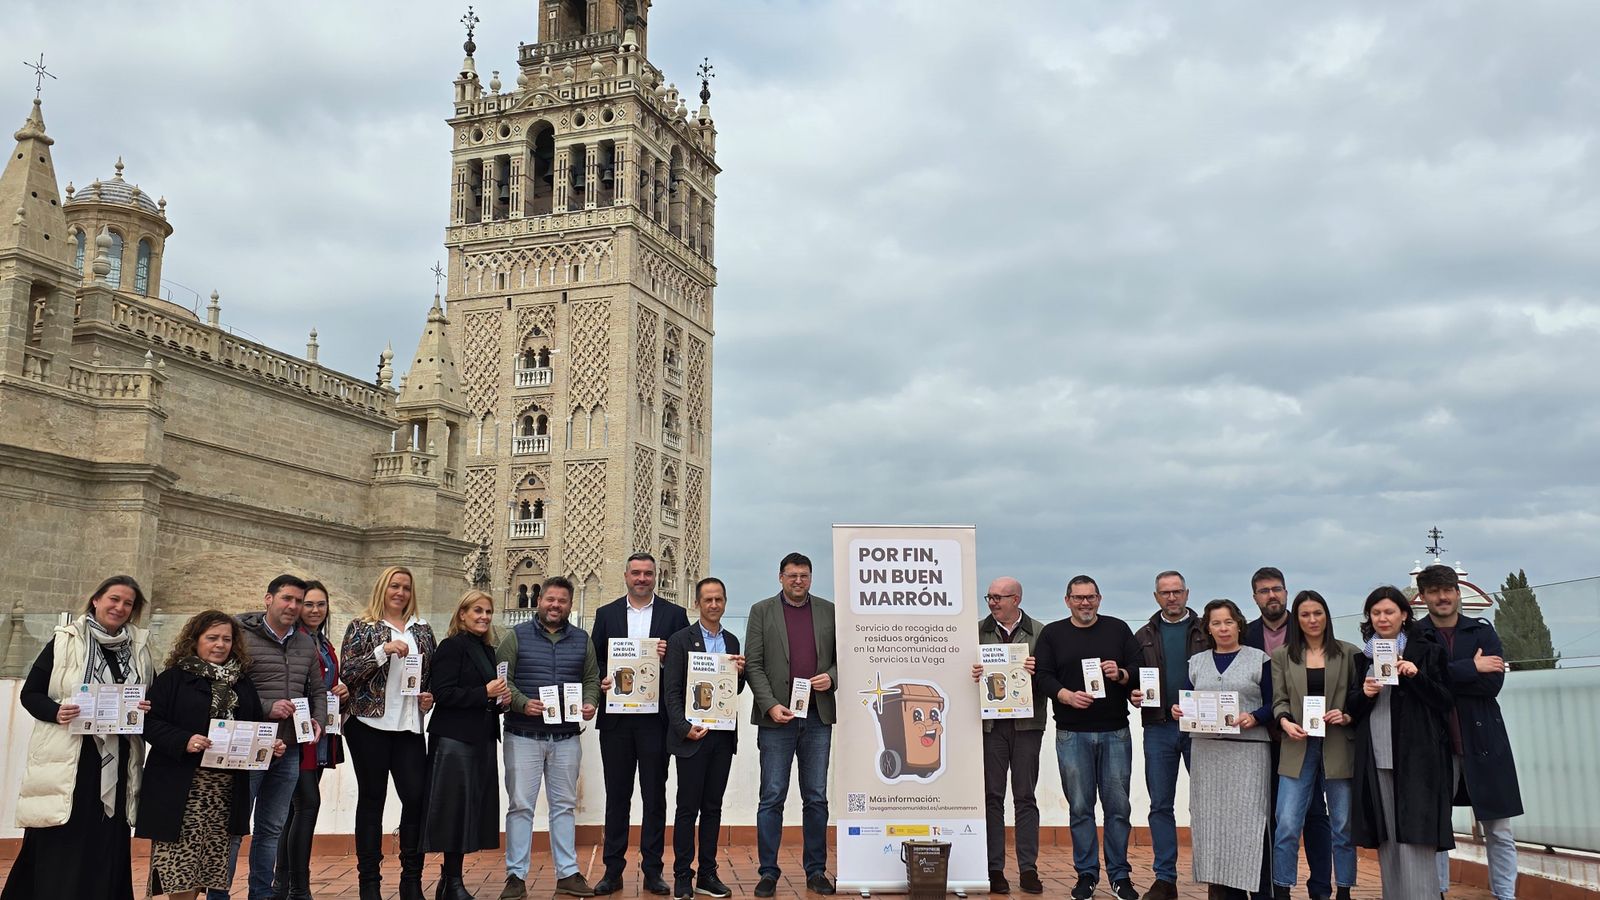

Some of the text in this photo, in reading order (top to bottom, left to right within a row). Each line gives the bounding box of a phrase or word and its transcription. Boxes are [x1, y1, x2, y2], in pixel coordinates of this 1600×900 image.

[859, 548, 938, 566] POR FIN,
[859, 569, 942, 584] UN BUEN
[860, 586, 952, 606] MARRÓN.
[855, 624, 958, 634] Servicio de recogida de
[904, 634, 948, 644] orgánicos
[866, 645, 875, 653] la
[876, 645, 946, 653] Mancomunidad
[869, 656, 945, 665] Servicios La Vega
[888, 795, 941, 803] información:
